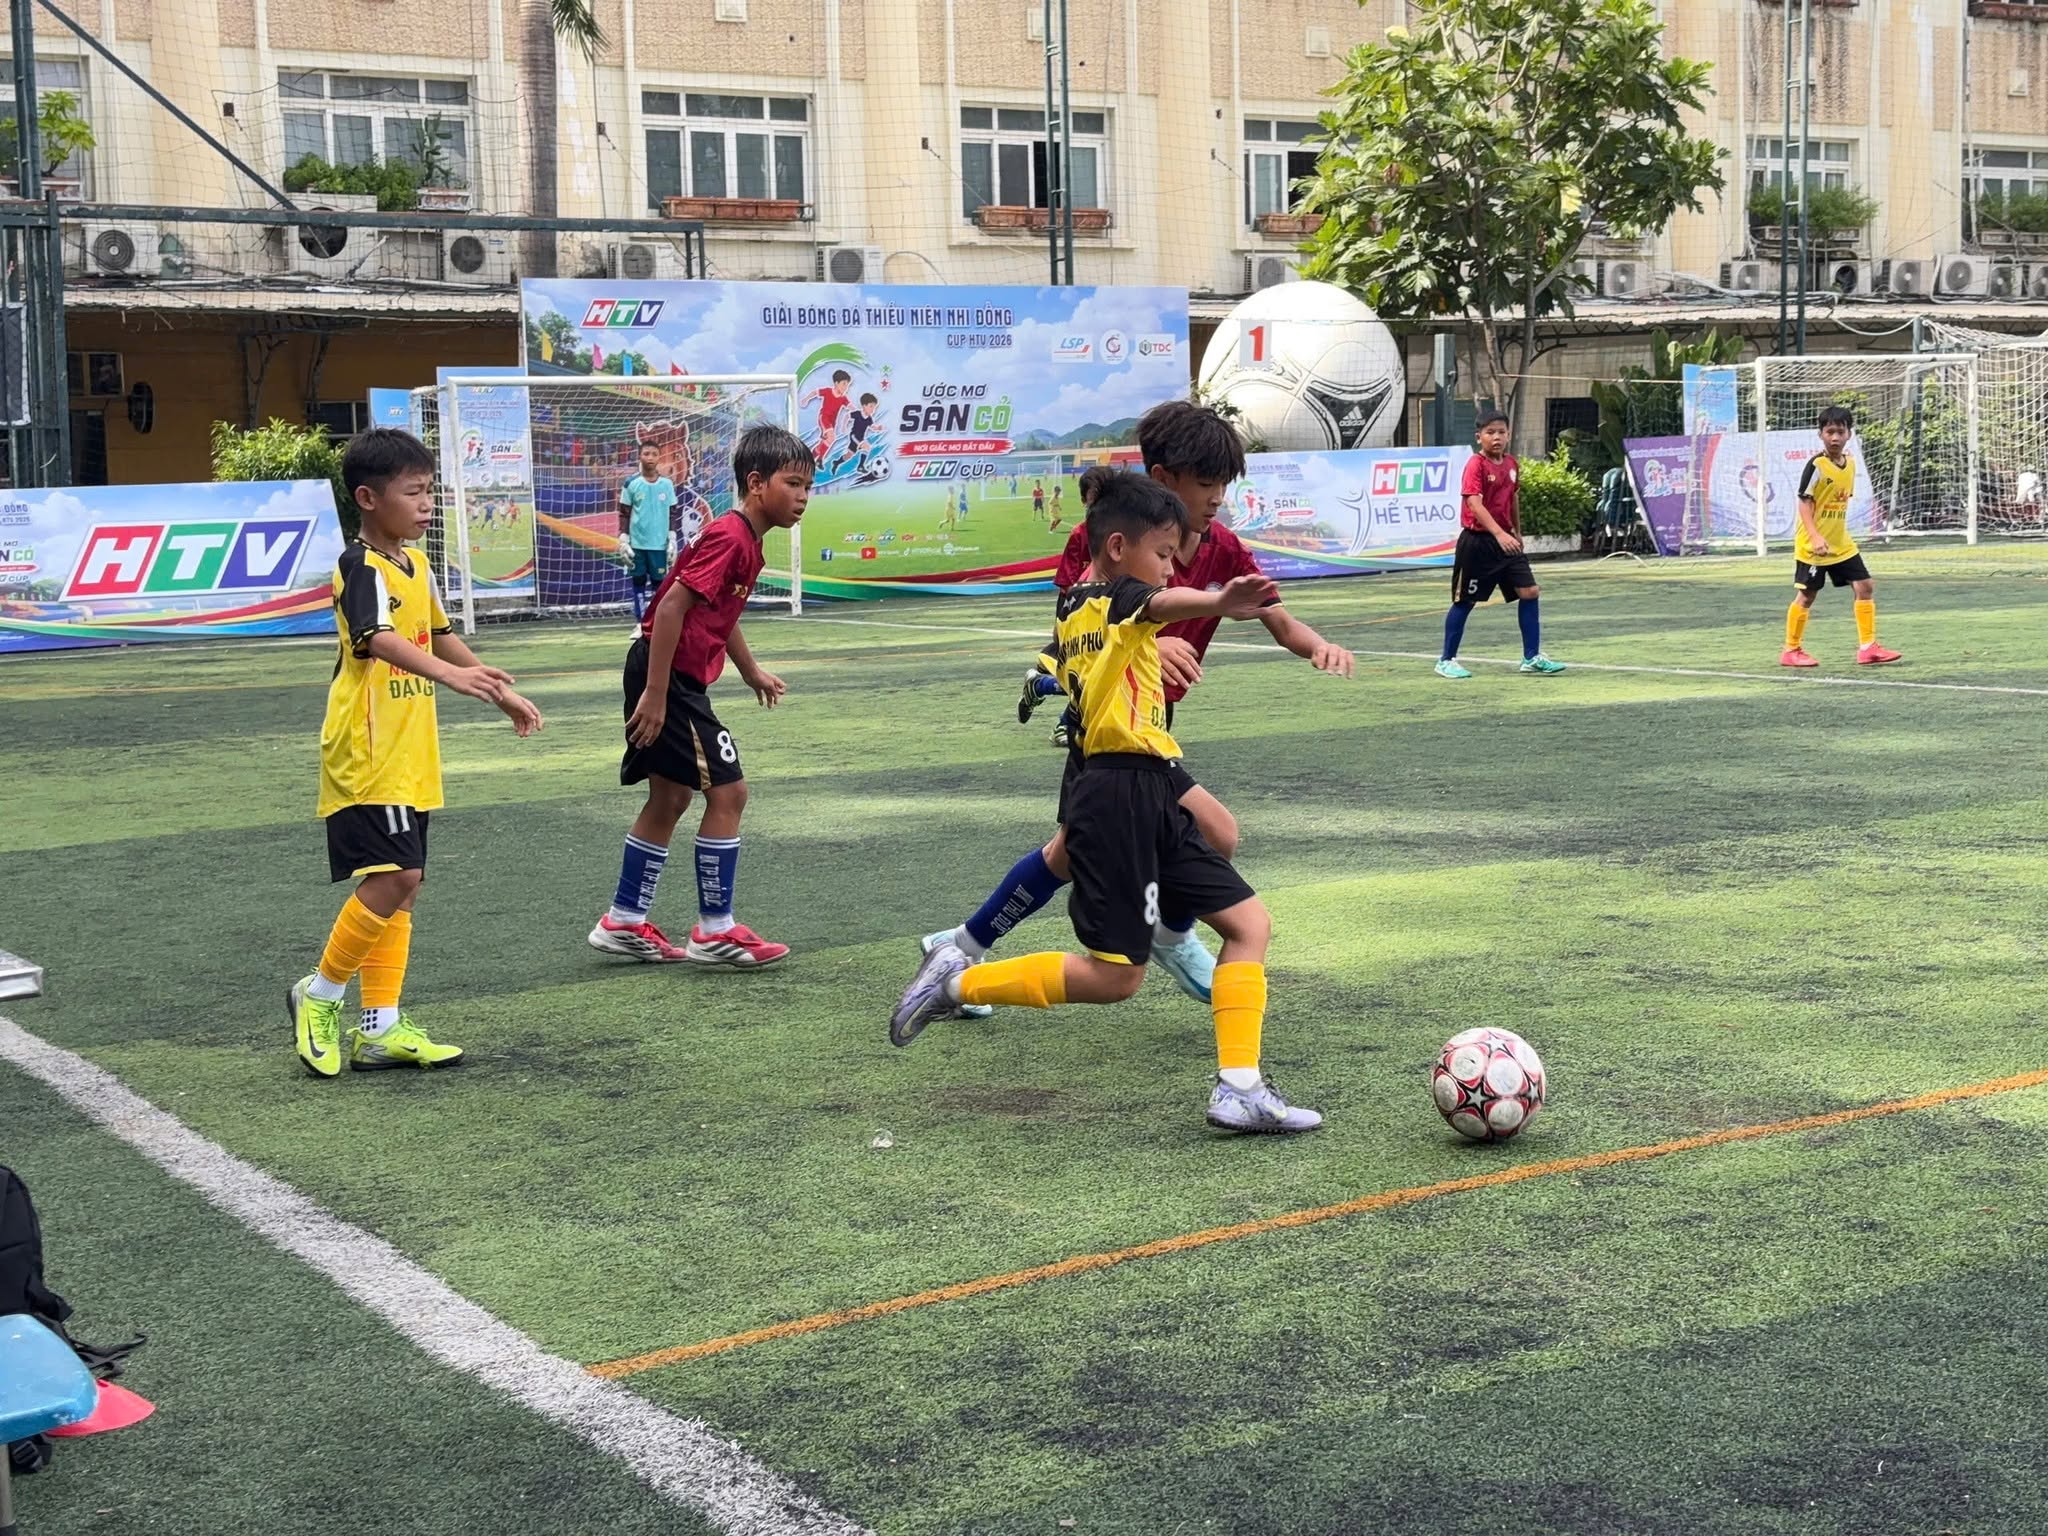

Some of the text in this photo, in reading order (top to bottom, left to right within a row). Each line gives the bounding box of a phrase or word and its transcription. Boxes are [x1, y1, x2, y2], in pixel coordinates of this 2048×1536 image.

[583, 301, 665, 326] HTV
[763, 301, 1012, 327] GIẢI BÓNG ĐÁ THIẾU NIÊN NHI ĐỒNG
[969, 334, 987, 346] HTV
[1153, 343, 1171, 352] TDC
[1248, 326, 1264, 361] 1
[923, 382, 989, 398] ƯỚC MƠ
[900, 396, 1012, 432] SÂN CỎ
[909, 461, 994, 478] HTV CÚP
[1372, 464, 1447, 493] HTV
[1404, 504, 1456, 524] THAO
[74, 526, 308, 588] HTV
[1468, 579, 1478, 594] 5
[717, 730, 737, 764] 8
[385, 805, 410, 835] 11
[1143, 881, 1161, 926] 8
